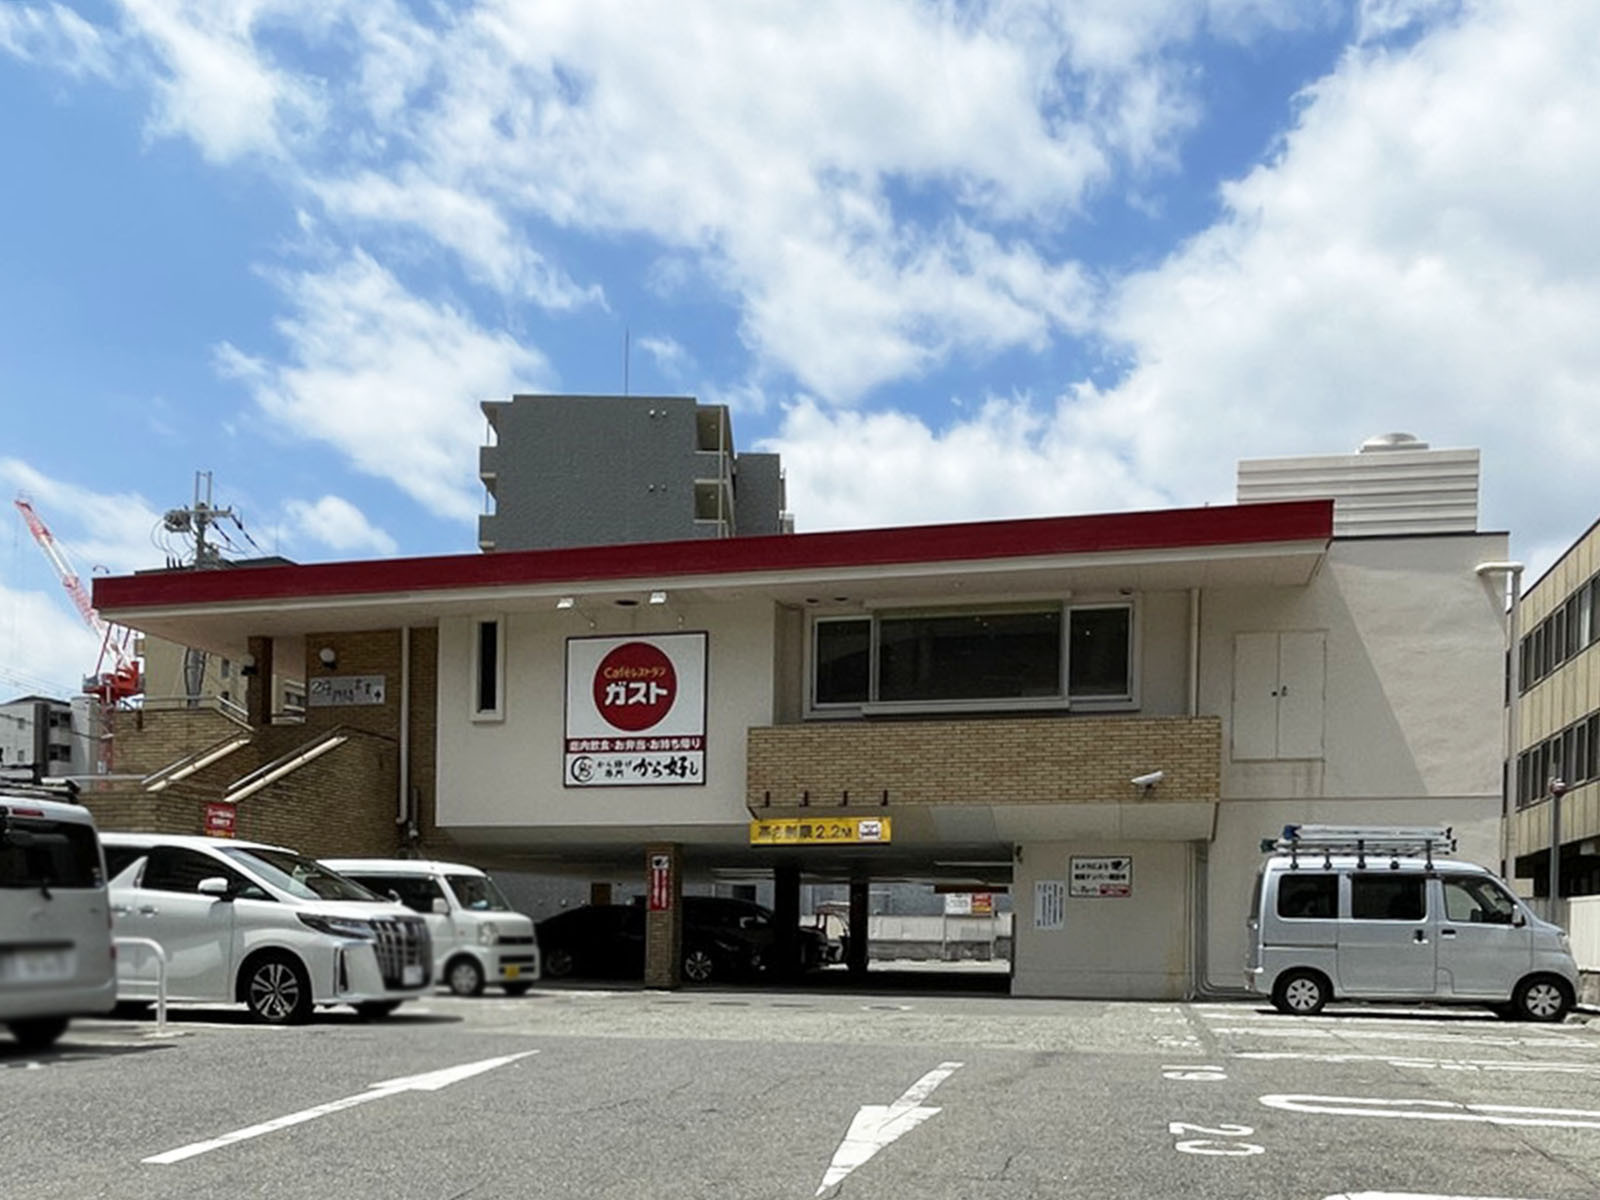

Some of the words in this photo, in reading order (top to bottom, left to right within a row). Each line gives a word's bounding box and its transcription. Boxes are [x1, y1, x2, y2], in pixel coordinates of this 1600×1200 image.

[604, 681, 668, 706] ガスト
[632, 756, 699, 779] から好し
[1168, 1121, 1266, 1156] 20
